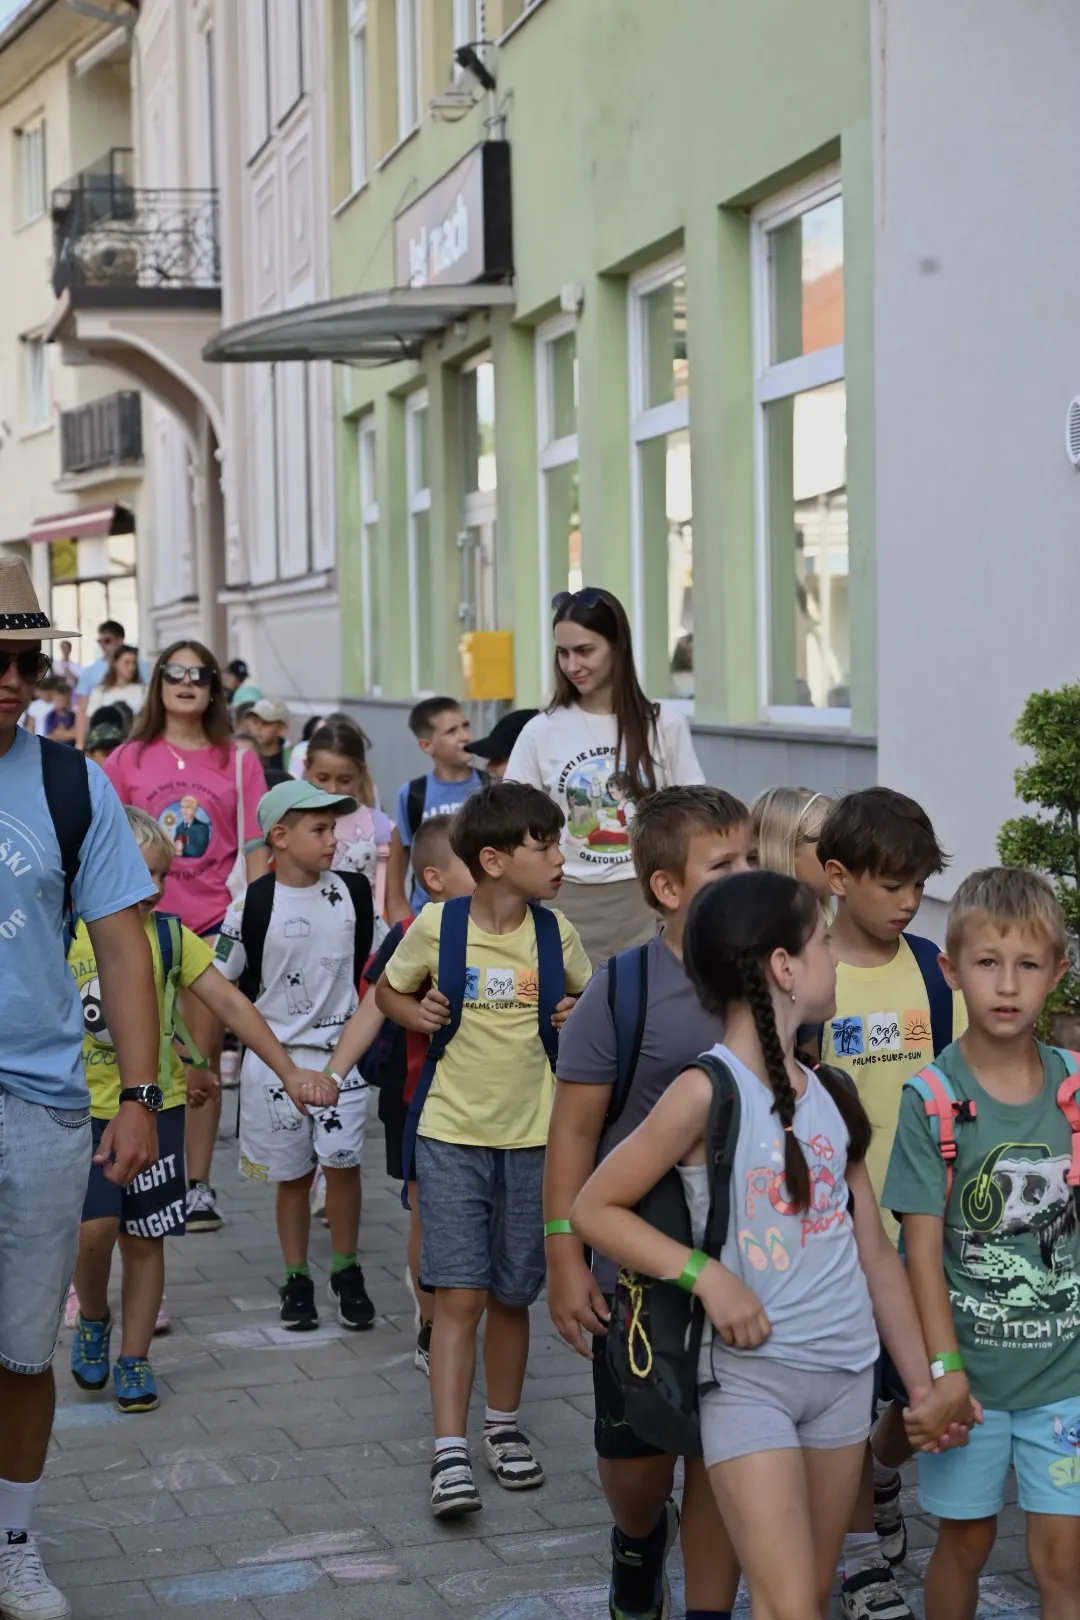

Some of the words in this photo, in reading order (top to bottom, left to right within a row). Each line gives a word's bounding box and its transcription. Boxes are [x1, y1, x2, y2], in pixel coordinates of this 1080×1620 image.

[852, 1055, 877, 1066] PALMS
[881, 1052, 903, 1063] SURF
[908, 1051, 922, 1060] SUN
[126, 1199, 185, 1238] RIGHT
[949, 1289, 1010, 1322] T-REX
[973, 1320, 1051, 1338] GLITCH
[974, 1338, 999, 1347] PIXEL
[1002, 1340, 1053, 1349] DISTORTION
